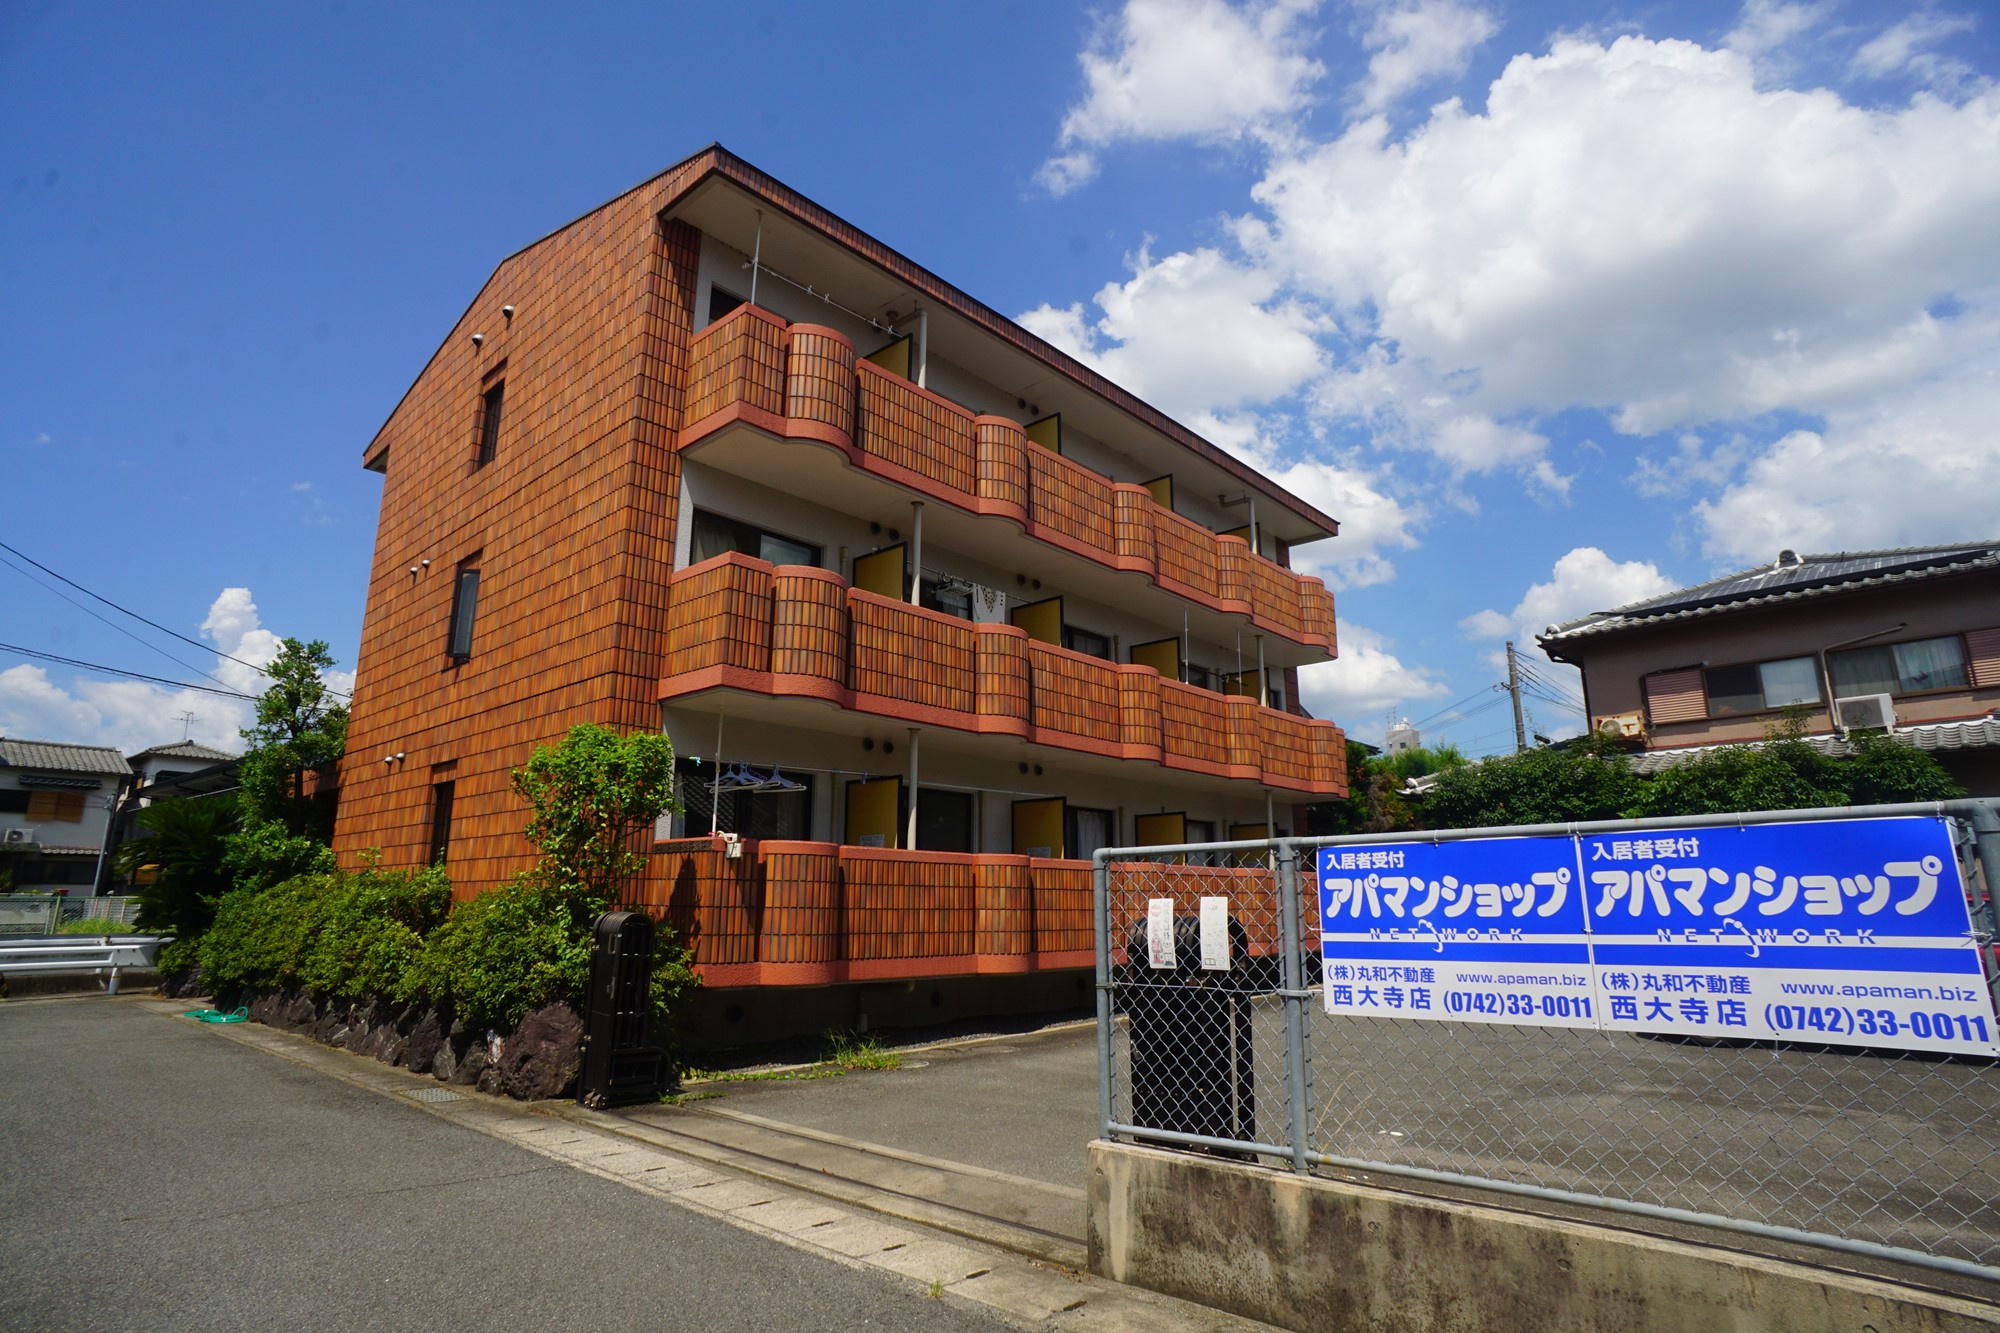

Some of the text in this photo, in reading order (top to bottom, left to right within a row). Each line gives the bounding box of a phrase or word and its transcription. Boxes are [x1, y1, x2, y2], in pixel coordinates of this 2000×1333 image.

[1326, 851, 1405, 870] 入居者受付
[1592, 837, 1699, 861] 入居者受付
[1324, 867, 1571, 917] アパマンショップ
[1591, 855, 1943, 917] アパマンショップ
[1327, 965, 1436, 983] (株)丸和不動産
[1456, 972, 1587, 987] www.apaman.biz
[1600, 972, 1752, 996] (株)丸和不動産
[1333, 985, 1432, 1010] 西大寺店
[1443, 991, 1592, 1018] (0742)33-0011
[1781, 982, 1979, 1003] www.apaman.biz
[1612, 997, 1747, 1027] 西大寺店
[1764, 1003, 1990, 1043] (0742)33-0011
